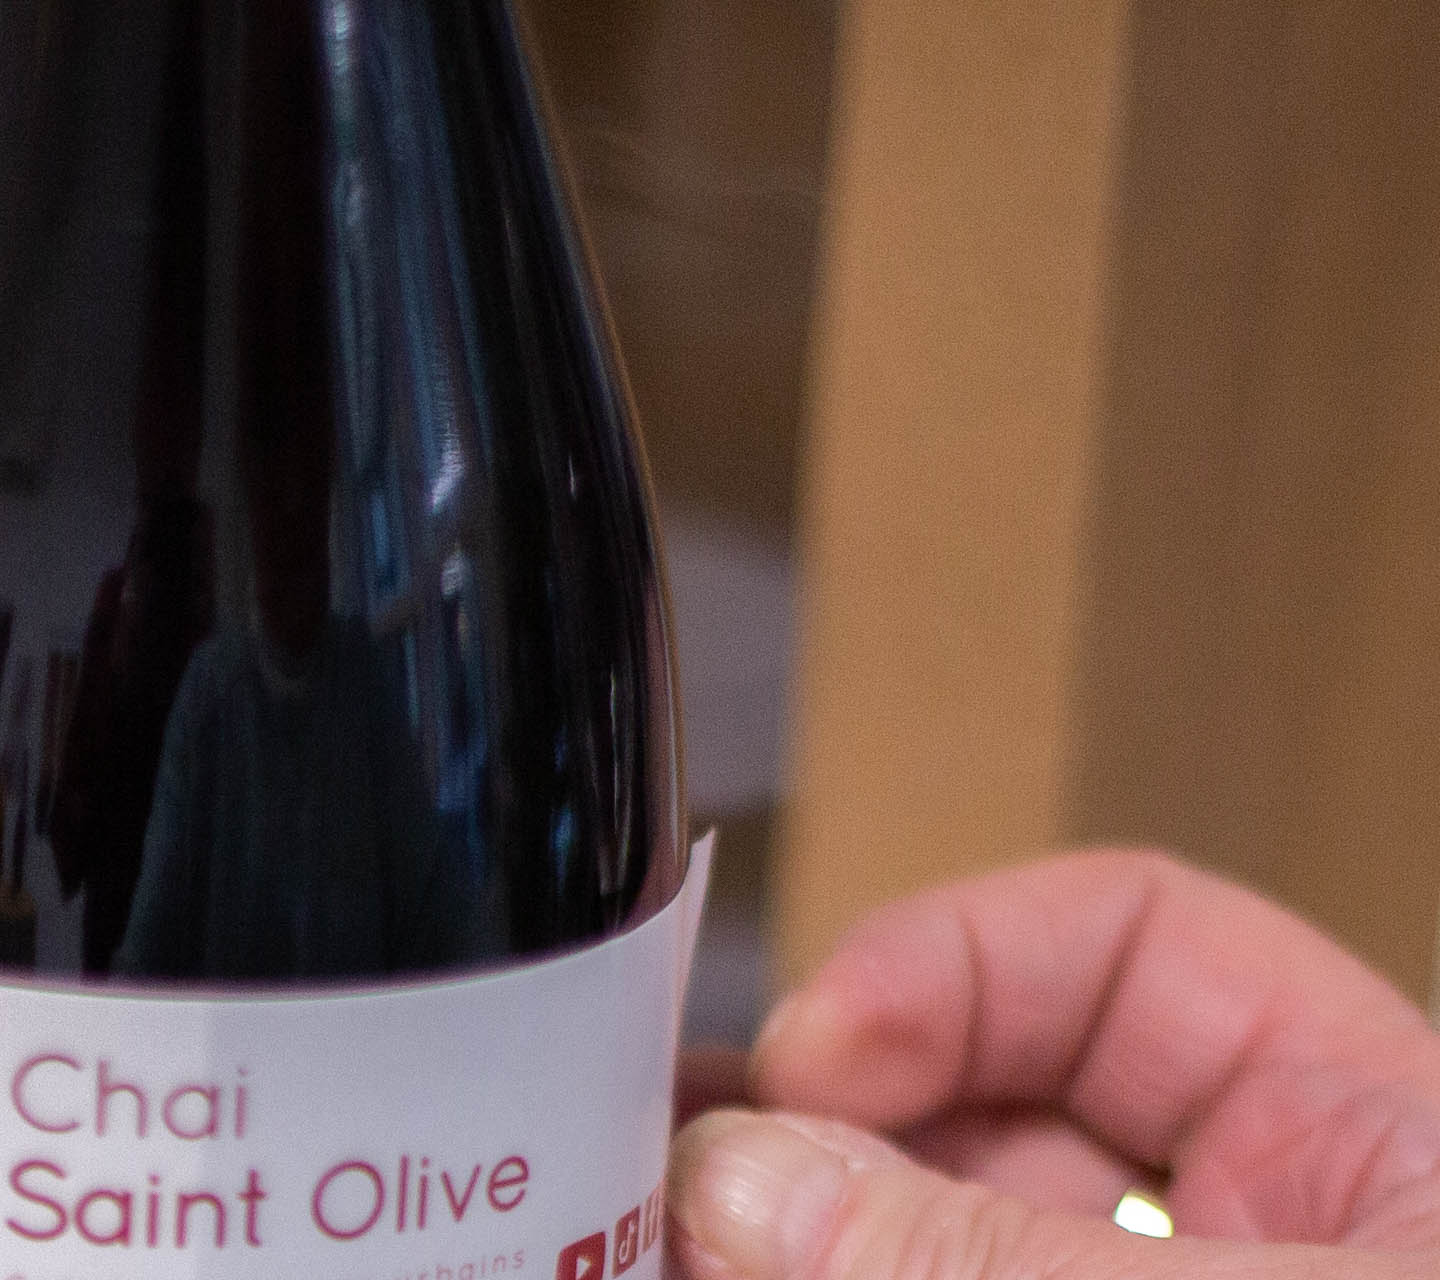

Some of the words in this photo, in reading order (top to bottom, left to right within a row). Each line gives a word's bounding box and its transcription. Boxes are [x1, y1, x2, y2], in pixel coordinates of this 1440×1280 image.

[10, 1052, 252, 1140] Chai
[4, 1158, 269, 1250] Saint
[311, 1152, 531, 1243] Olive
